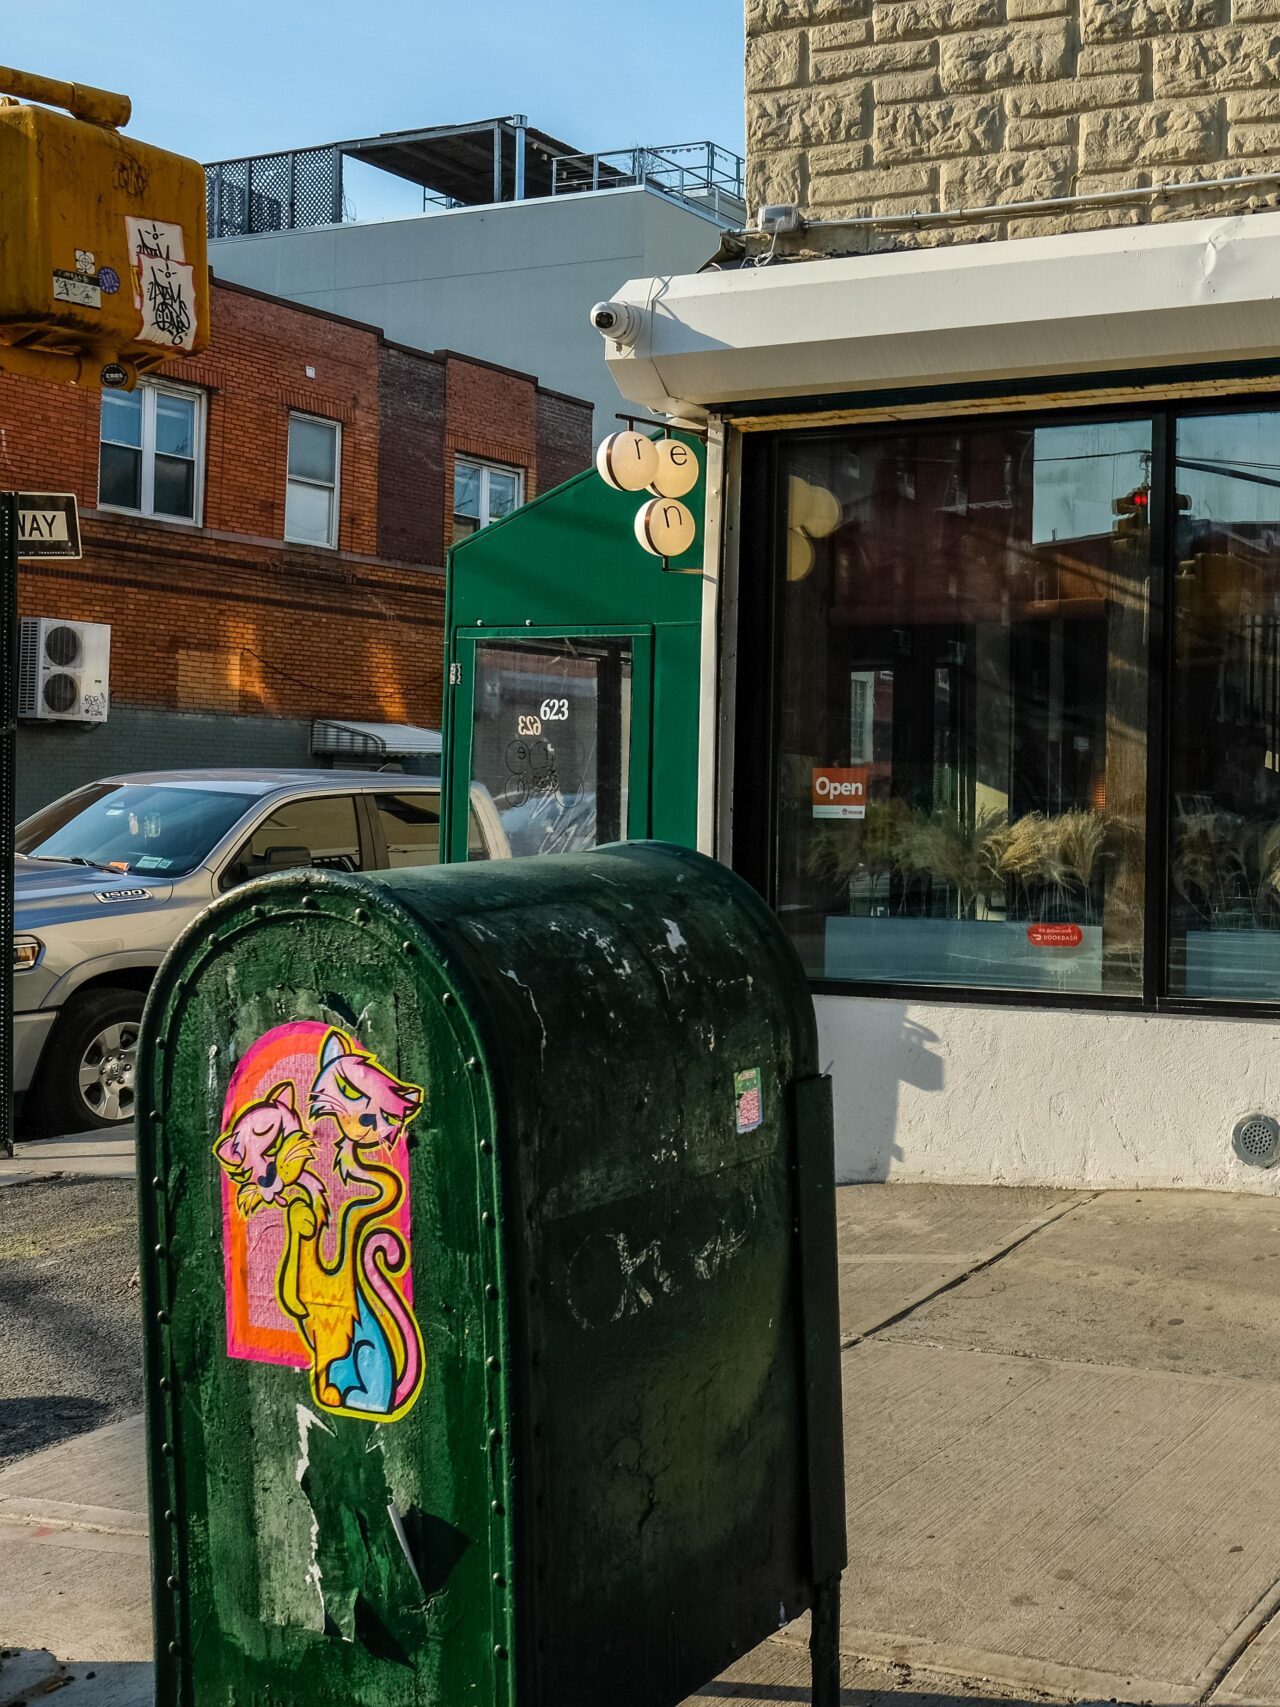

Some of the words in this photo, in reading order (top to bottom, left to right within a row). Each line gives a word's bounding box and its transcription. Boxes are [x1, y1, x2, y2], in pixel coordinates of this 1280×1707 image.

[540, 699, 569, 720] 623
[815, 776, 863, 800] Open
[104, 889, 143, 898] 1500
